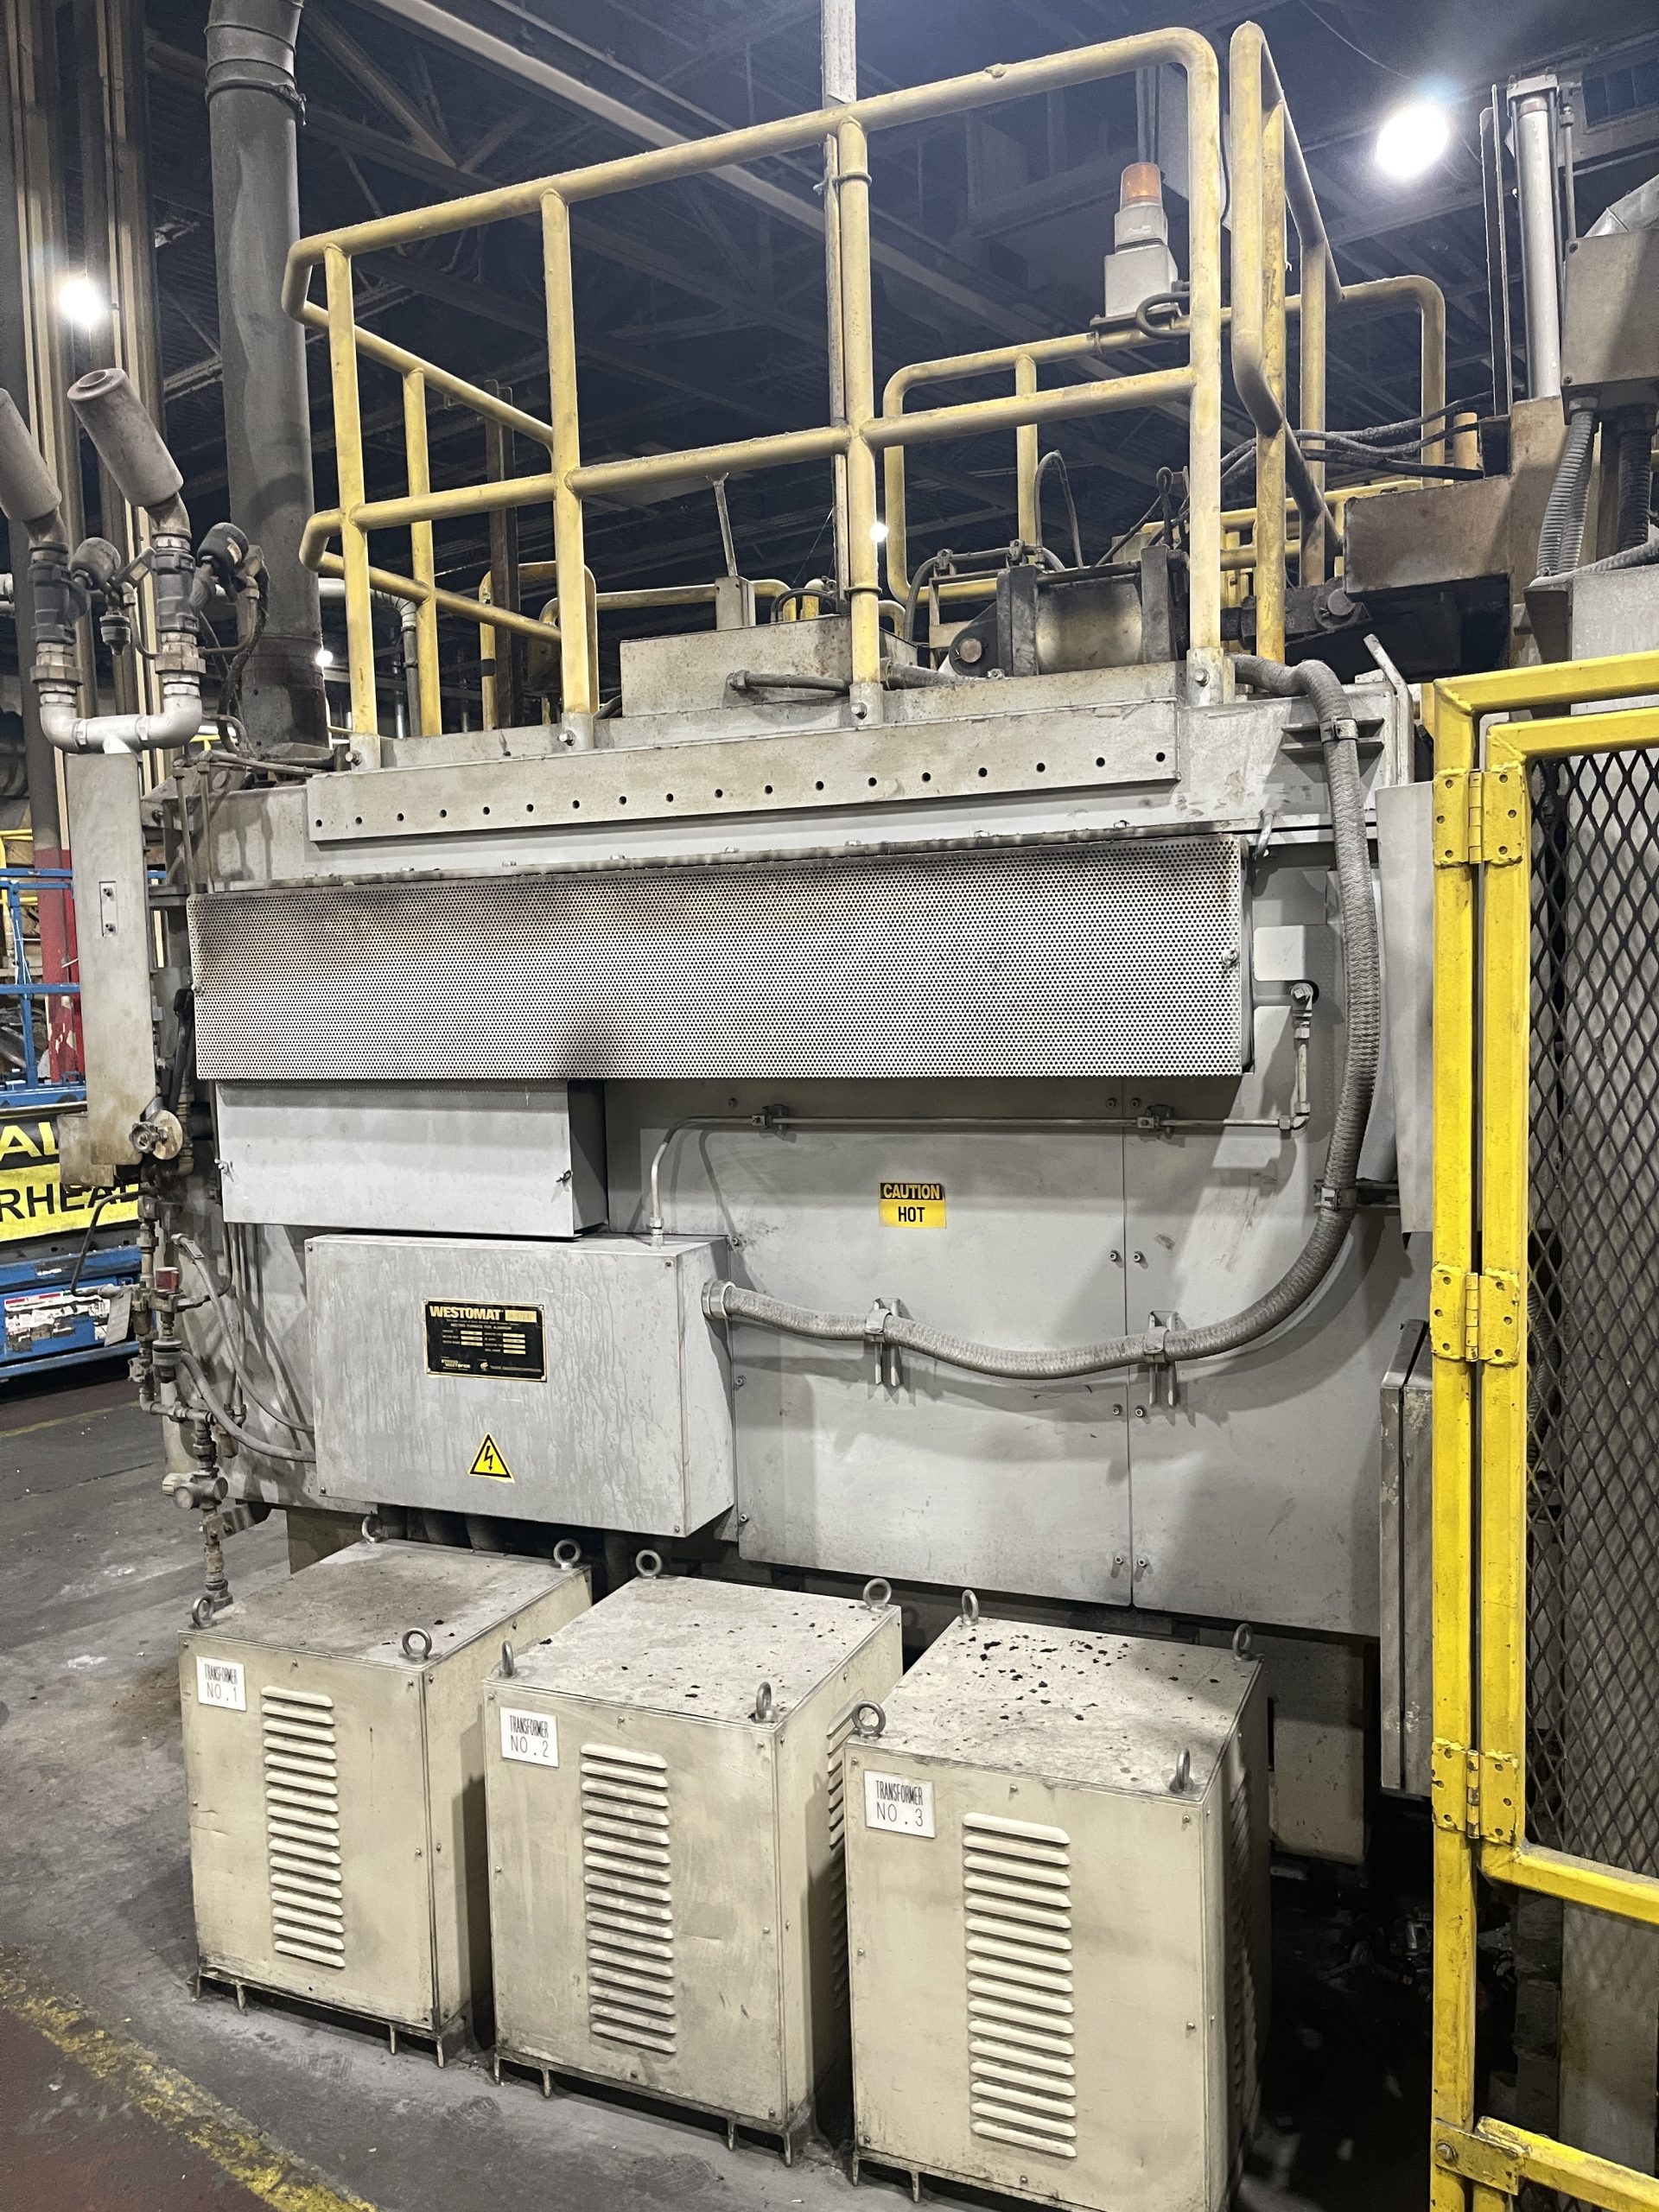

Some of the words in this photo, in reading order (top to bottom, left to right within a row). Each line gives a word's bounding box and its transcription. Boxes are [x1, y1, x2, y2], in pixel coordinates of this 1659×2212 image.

[883, 1184, 940, 1199] CAUTION
[898, 1206, 925, 1223] HOT
[429, 1306, 501, 1321] WESTOMAT
[205, 1663, 238, 1685] TRANSFORMER
[510, 1715, 549, 1738] TRANSFORMER
[875, 1781, 924, 1806] TRANSFORMER
